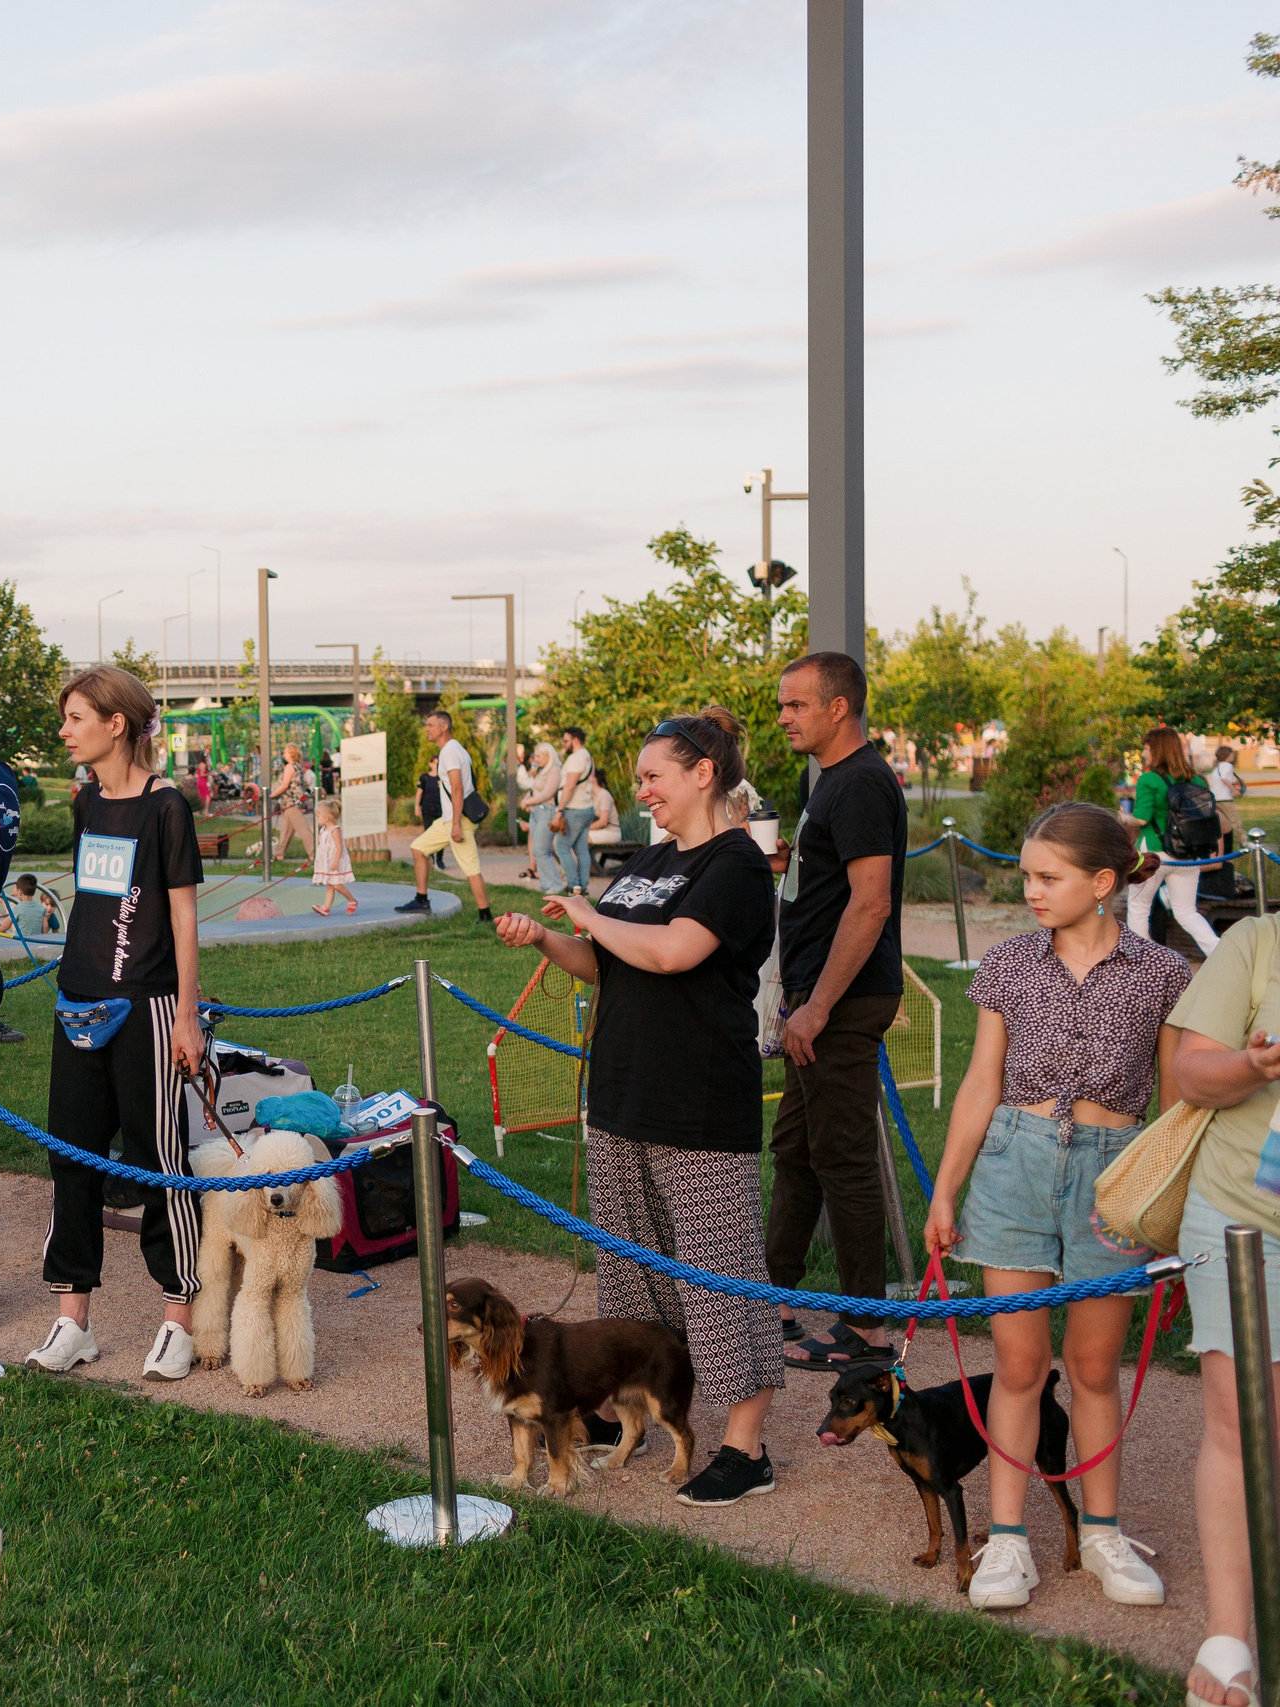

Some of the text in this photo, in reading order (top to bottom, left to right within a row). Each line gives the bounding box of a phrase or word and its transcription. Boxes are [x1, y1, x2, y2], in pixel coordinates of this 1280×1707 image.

[84, 852, 124, 879] 010
[112, 919, 131, 947] your
[112, 947, 130, 983] dreams
